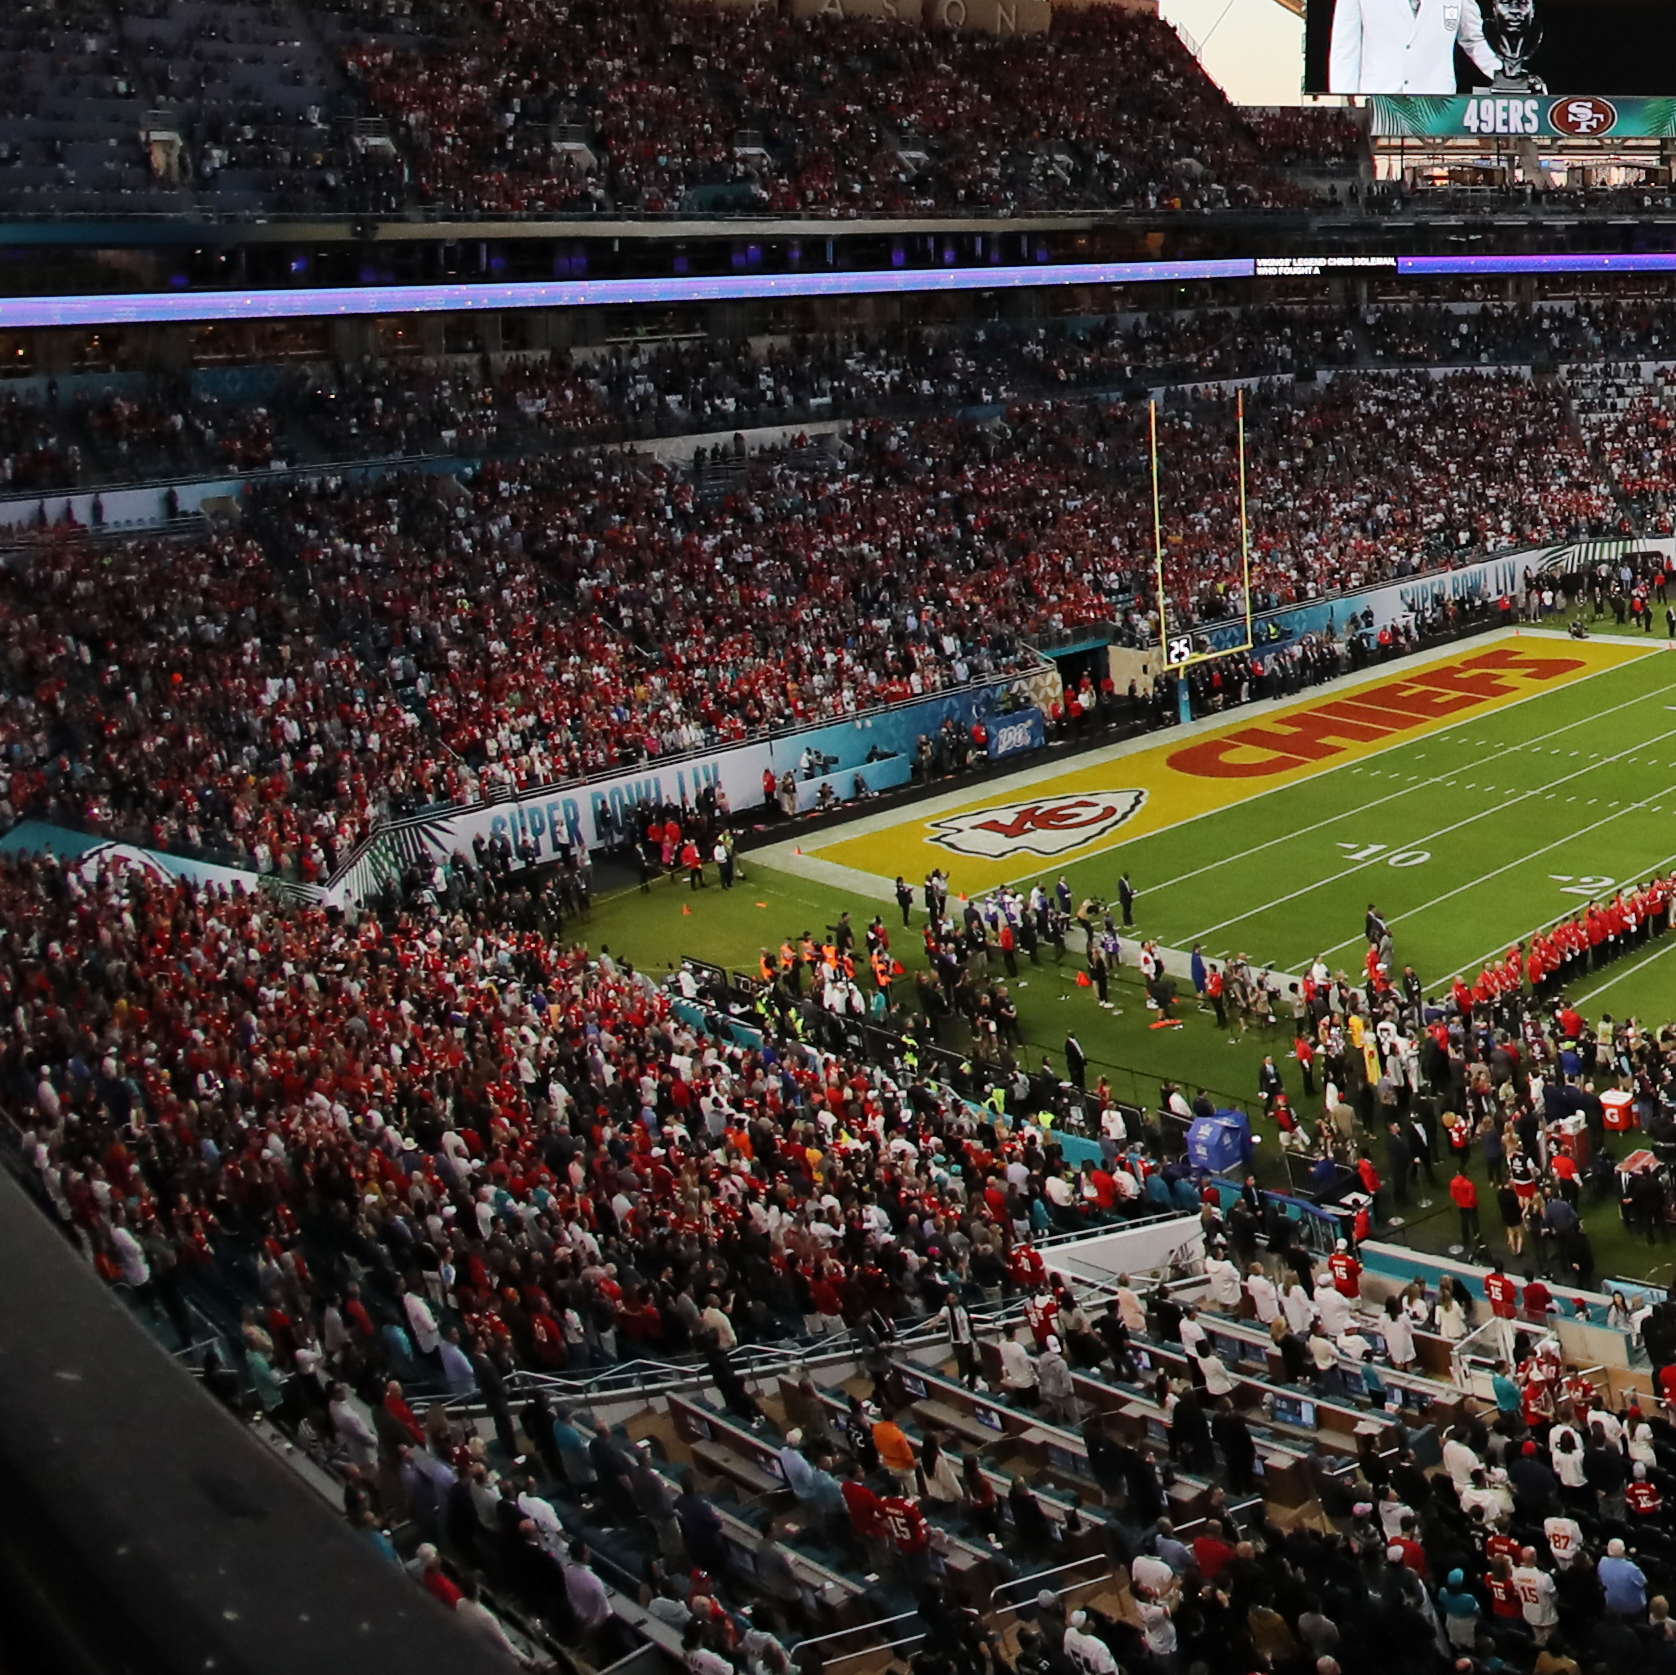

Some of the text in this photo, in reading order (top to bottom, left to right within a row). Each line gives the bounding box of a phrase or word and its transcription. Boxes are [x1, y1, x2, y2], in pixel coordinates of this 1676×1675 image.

[1463, 99, 1539, 133] 49ERS
[1256, 266, 1278, 275] WHO
[1278, 266, 1312, 275] FOUGHT
[1293, 258, 1327, 267] LEGEND
[1327, 257, 1354, 266] CHRIS
[1494, 562, 1516, 596] LIV
[1169, 638, 1191, 664] 25
[1167, 648, 1587, 779] CHIEFS
[1342, 844, 1432, 868] 10
[1605, 1108, 1618, 1123] G
[1334, 1266, 1347, 1280] 15
[1490, 1285, 1503, 1301] 15
[887, 1516, 911, 1540] 15
[1553, 1535, 1571, 1551] 87
[1493, 1584, 1506, 1600] 15
[1521, 1585, 1539, 1604] 15
